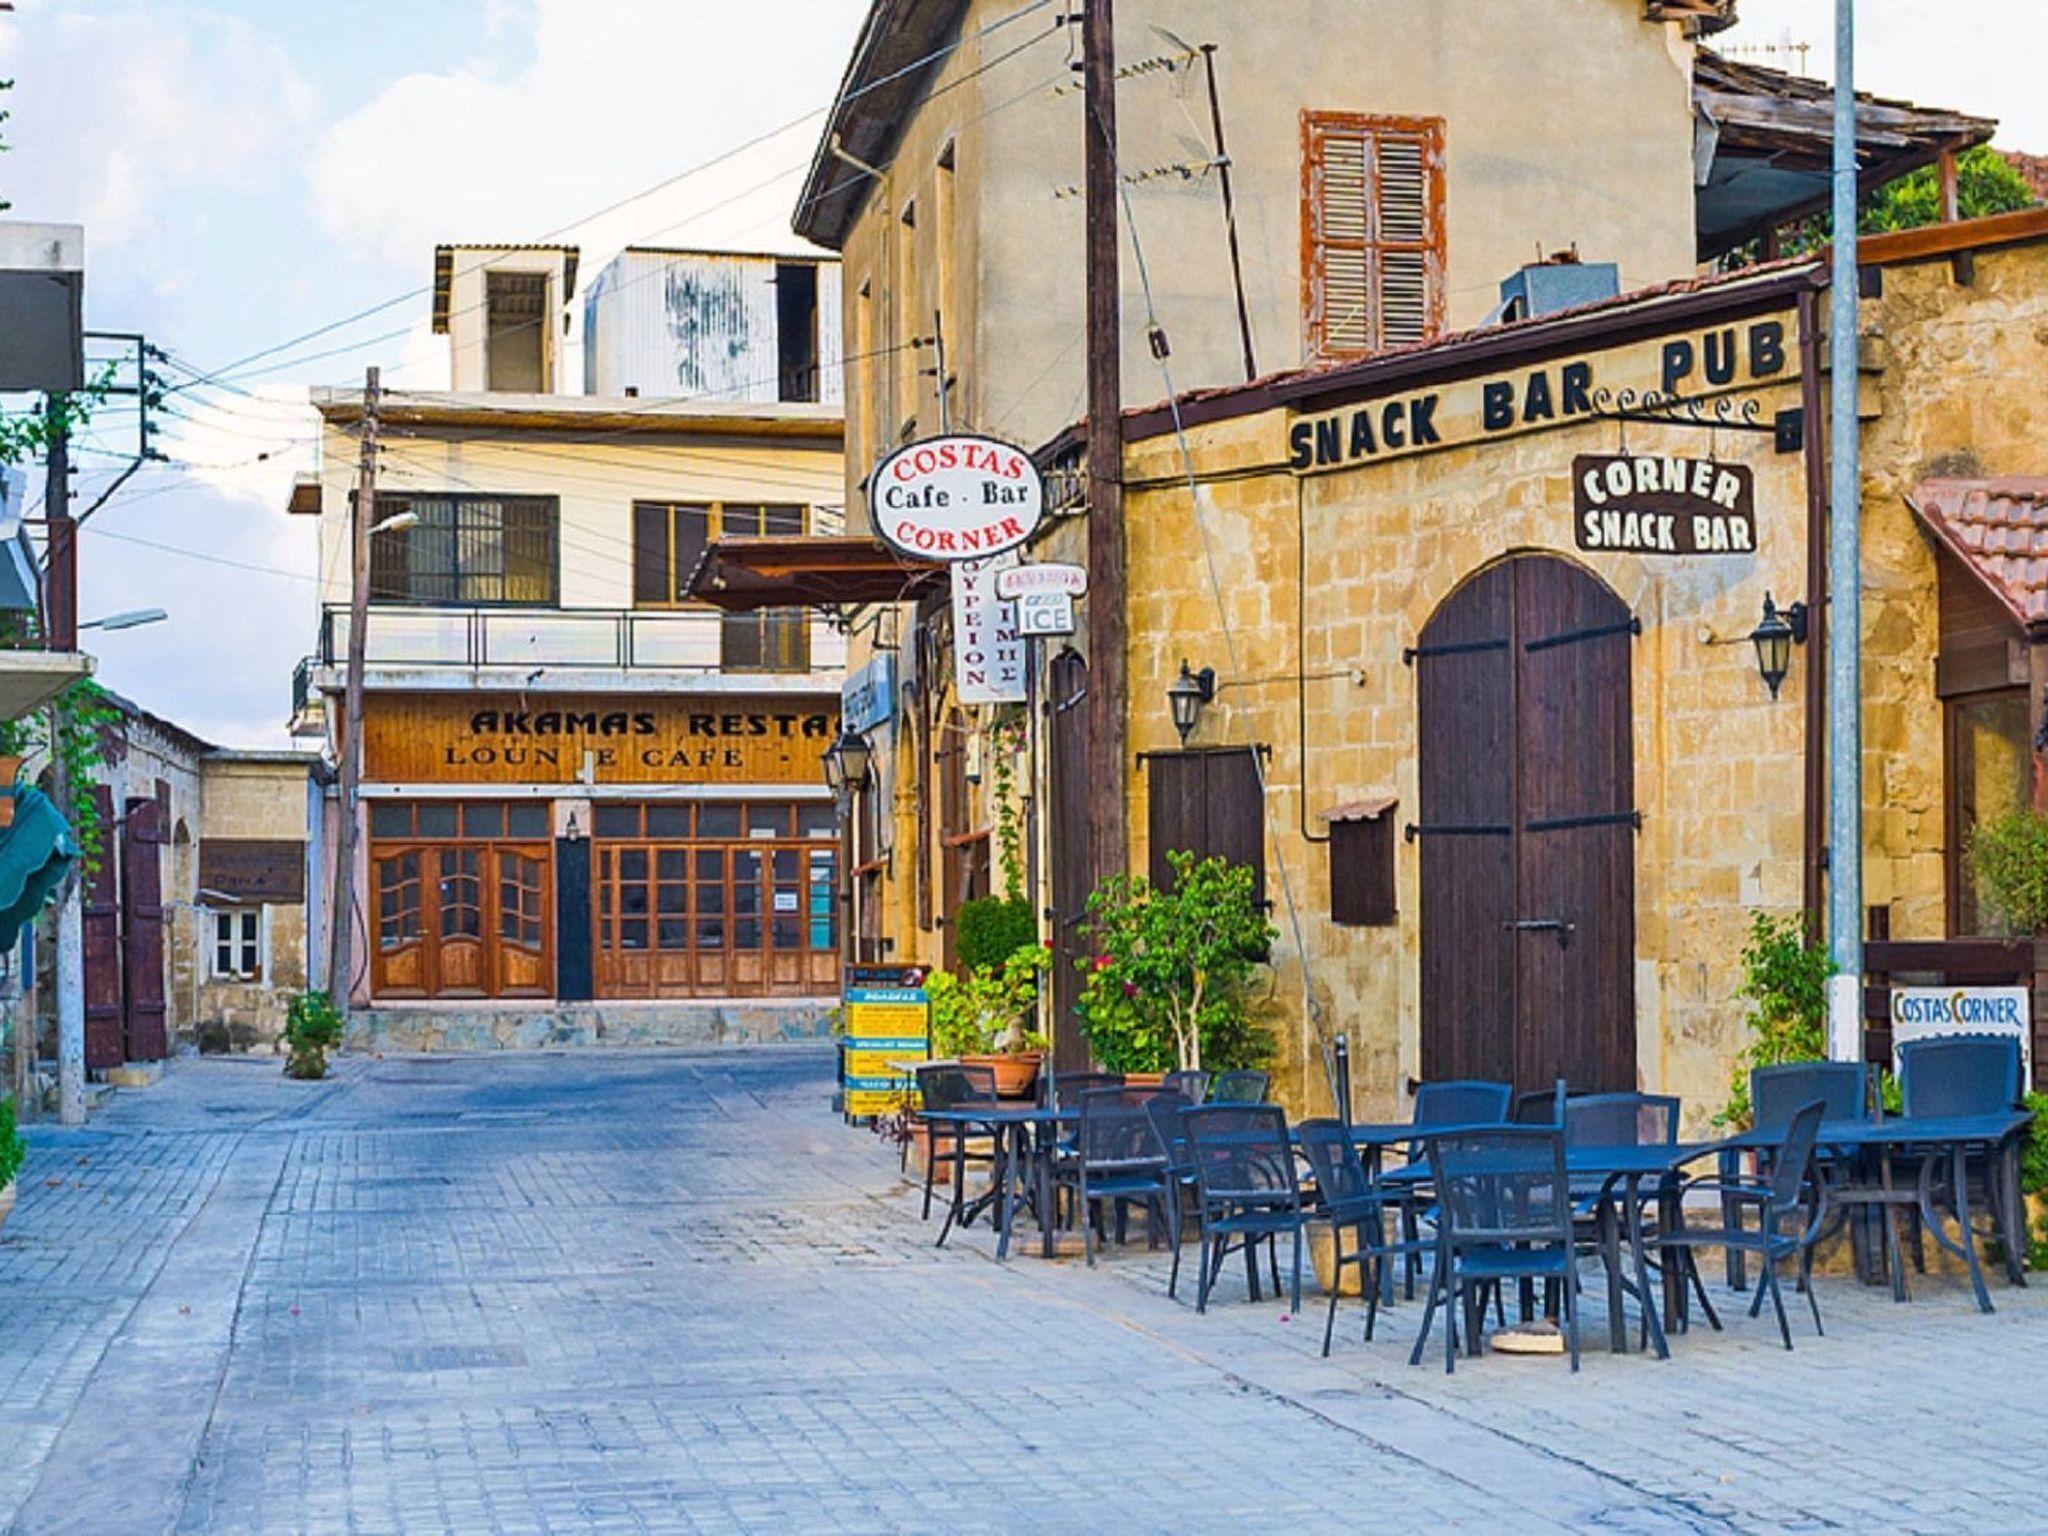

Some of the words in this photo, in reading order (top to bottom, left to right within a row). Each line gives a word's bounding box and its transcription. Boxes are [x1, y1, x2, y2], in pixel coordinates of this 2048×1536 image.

[1290, 393, 1440, 468] SNACK
[1483, 361, 1595, 431] BAR
[1661, 321, 1785, 394] PUB
[893, 444, 1025, 482] COSTAS
[885, 483, 950, 509] Cafe
[981, 479, 1028, 505] Bar
[1583, 457, 1741, 510] CORNER
[896, 517, 1025, 551] CORNER
[1584, 509, 1676, 551] SNACK
[1693, 514, 1752, 551] BAR
[1025, 608, 1067, 630] ICE
[470, 711, 656, 737] AKAMAS
[445, 748, 617, 767] LOUNE
[641, 750, 744, 767] CAFE
